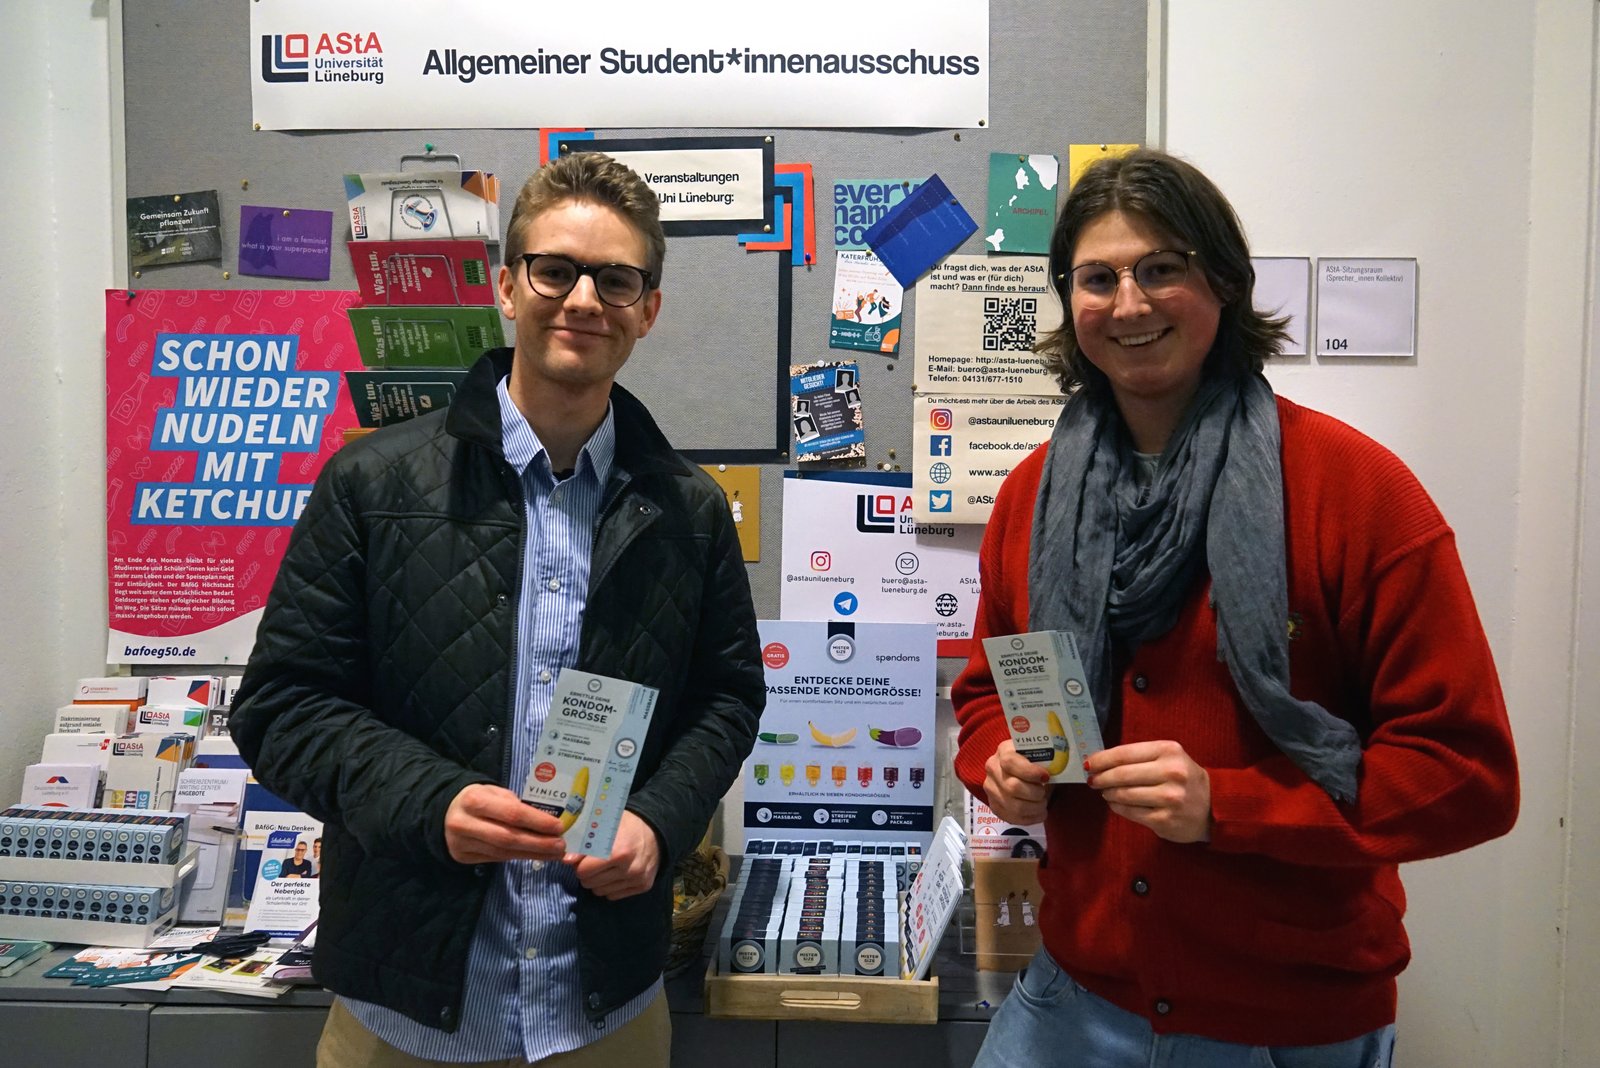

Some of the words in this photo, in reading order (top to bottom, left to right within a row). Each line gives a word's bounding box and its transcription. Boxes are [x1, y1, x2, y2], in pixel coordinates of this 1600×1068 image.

[315, 32, 382, 54] AStA
[315, 57, 383, 68] Universität
[423, 49, 590, 83] Allgemeiner
[315, 70, 384, 84] Lüneburg
[645, 172, 739, 184] Veranstaltungen
[659, 193, 675, 203] Uni
[679, 192, 734, 205] Lüneburg:
[140, 210, 182, 220] Gemeinsam
[184, 208, 209, 216] Zukunft
[835, 205, 890, 224] nam
[160, 218, 193, 228] pflanzen!
[835, 226, 870, 245] co
[266, 244, 282, 252] your
[285, 245, 328, 254] superpower?
[369, 251, 380, 271] tun,
[841, 253, 880, 262] KATERFRÜH
[944, 264, 967, 272] fragst
[969, 264, 988, 272] dich,
[1326, 266, 1383, 274] AStA-Sitzungsraum
[375, 273, 385, 295] Was
[988, 274, 1001, 282] (für
[371, 316, 382, 335] tun,
[377, 338, 385, 359] Was
[1326, 339, 1348, 350] 104
[158, 340, 290, 371] SCHON
[928, 356, 973, 364] Homepage:
[976, 356, 1050, 365] http://asta-luenebu
[958, 366, 1048, 375] buero@asta-lueneburg
[800, 374, 825, 383] MITGLIEDER
[366, 381, 376, 400] tun,
[804, 381, 824, 389] GESUCHT!
[185, 377, 330, 408] WIEDER
[370, 402, 381, 421] Was
[161, 413, 318, 444] NUDELN
[968, 417, 1054, 428] @astaunilueneburg
[202, 452, 274, 482] MIT
[968, 496, 994, 504] @ASt
[900, 525, 954, 537] Lüneburg
[787, 574, 854, 584] @astaunilueneburg
[882, 577, 928, 586] buero@asta-
[124, 646, 196, 658] bafoeg50.de
[999, 656, 1048, 667] KONDOM-
[1004, 665, 1045, 676] GRÖSSE
[794, 676, 853, 685] ENTDECKE
[857, 677, 890, 686] DEINE
[824, 687, 921, 697] KONDOMGRÖSSE!
[562, 697, 617, 714] KONDOM-
[562, 707, 607, 724] GRÖSSE
[530, 785, 567, 798] VINICO
